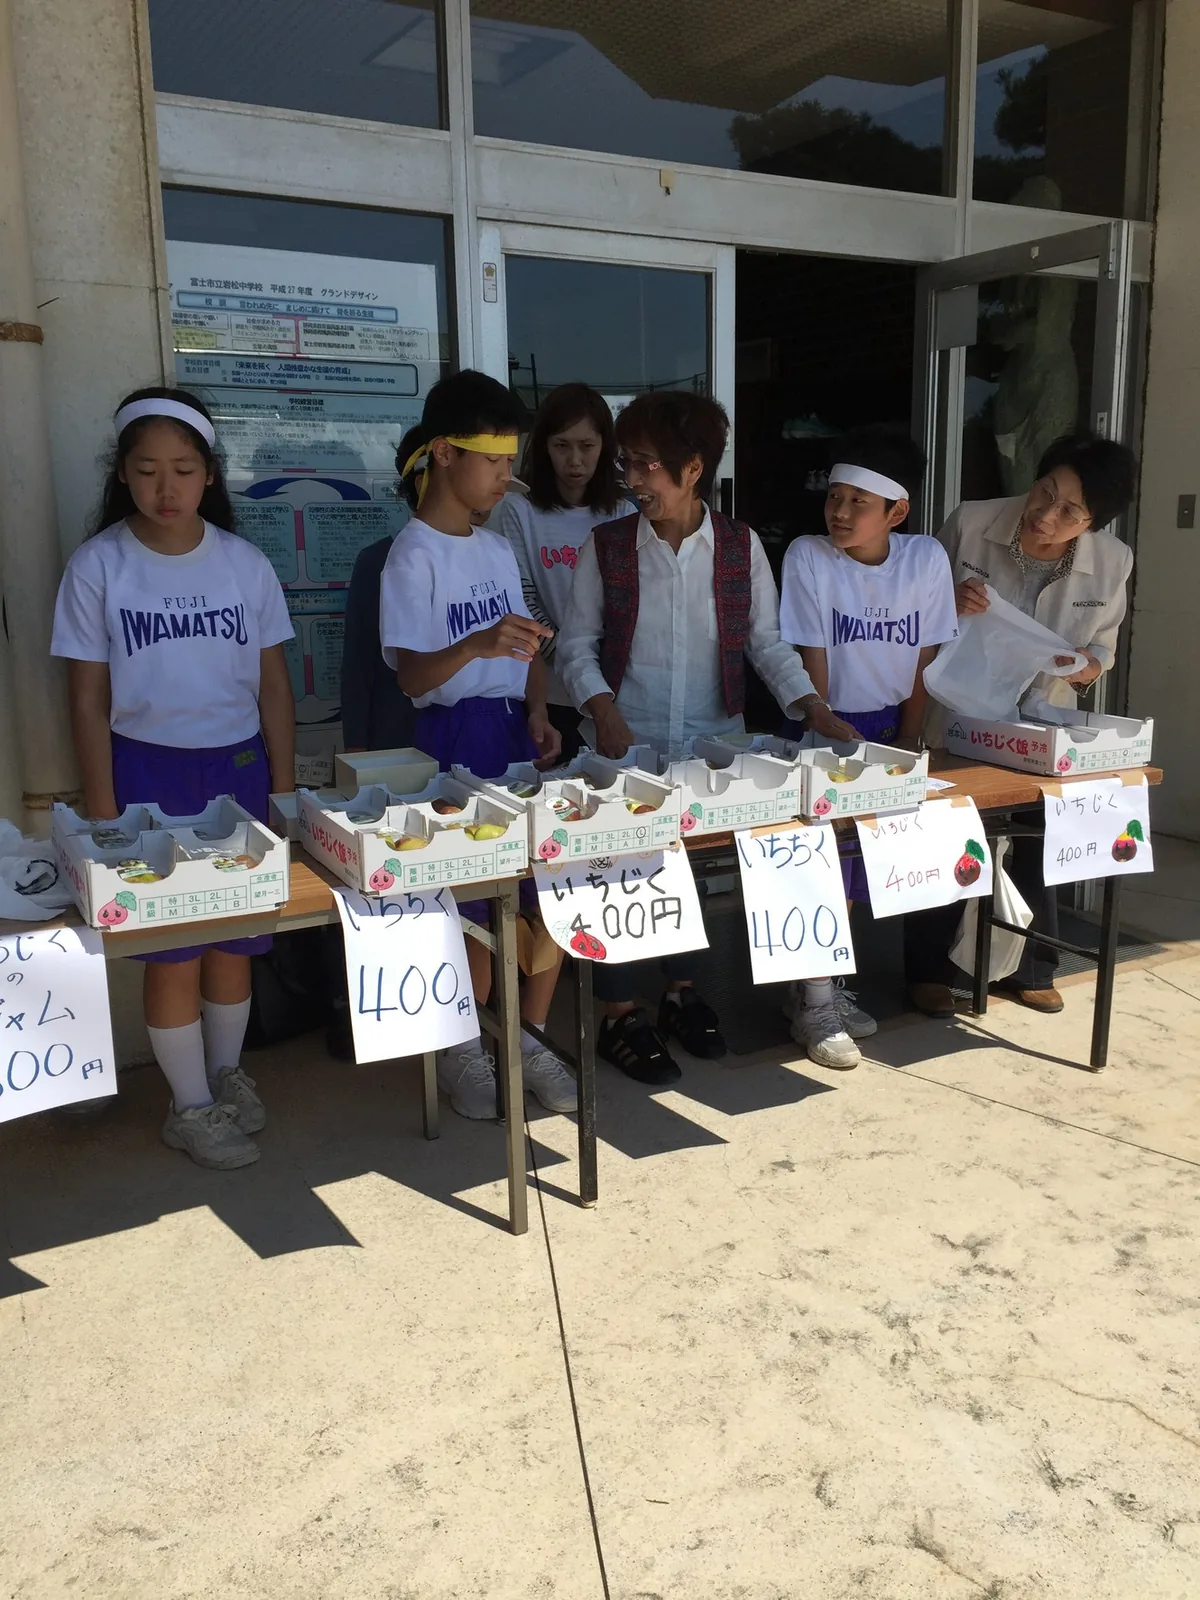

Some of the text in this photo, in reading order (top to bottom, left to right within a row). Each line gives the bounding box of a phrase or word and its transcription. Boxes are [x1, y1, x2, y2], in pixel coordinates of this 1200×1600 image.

[190, 278, 264, 292] 富士市立岩松中学校
[320, 287, 380, 301] グランドデザイン
[541, 544, 582, 569] いち
[469, 580, 498, 597] FUJI
[163, 595, 208, 609] FUJI
[863, 607, 890, 618] UJI
[119, 602, 248, 657] IWAMATSU
[1055, 793, 1118, 817] いちじく
[605, 832, 615, 840] 3L
[871, 813, 923, 839] いちじく
[737, 830, 831, 869] いちぢく
[1056, 842, 1097, 867] 400円
[428, 874, 436, 882] M
[464, 869, 471, 877] A
[482, 866, 488, 874] B
[444, 861, 455, 869] 3L
[462, 858, 473, 867] 2L
[551, 865, 667, 903] いちじく
[885, 865, 940, 892] 400円
[168, 888, 240, 906] 特 3L 2L L
[168, 899, 240, 917] M S A B
[569, 897, 682, 940] 400円
[752, 904, 849, 961] 400円
[6, 971, 24, 986] の
[358, 962, 471, 1021] 400円
[0, 1042, 104, 1092] 00円
